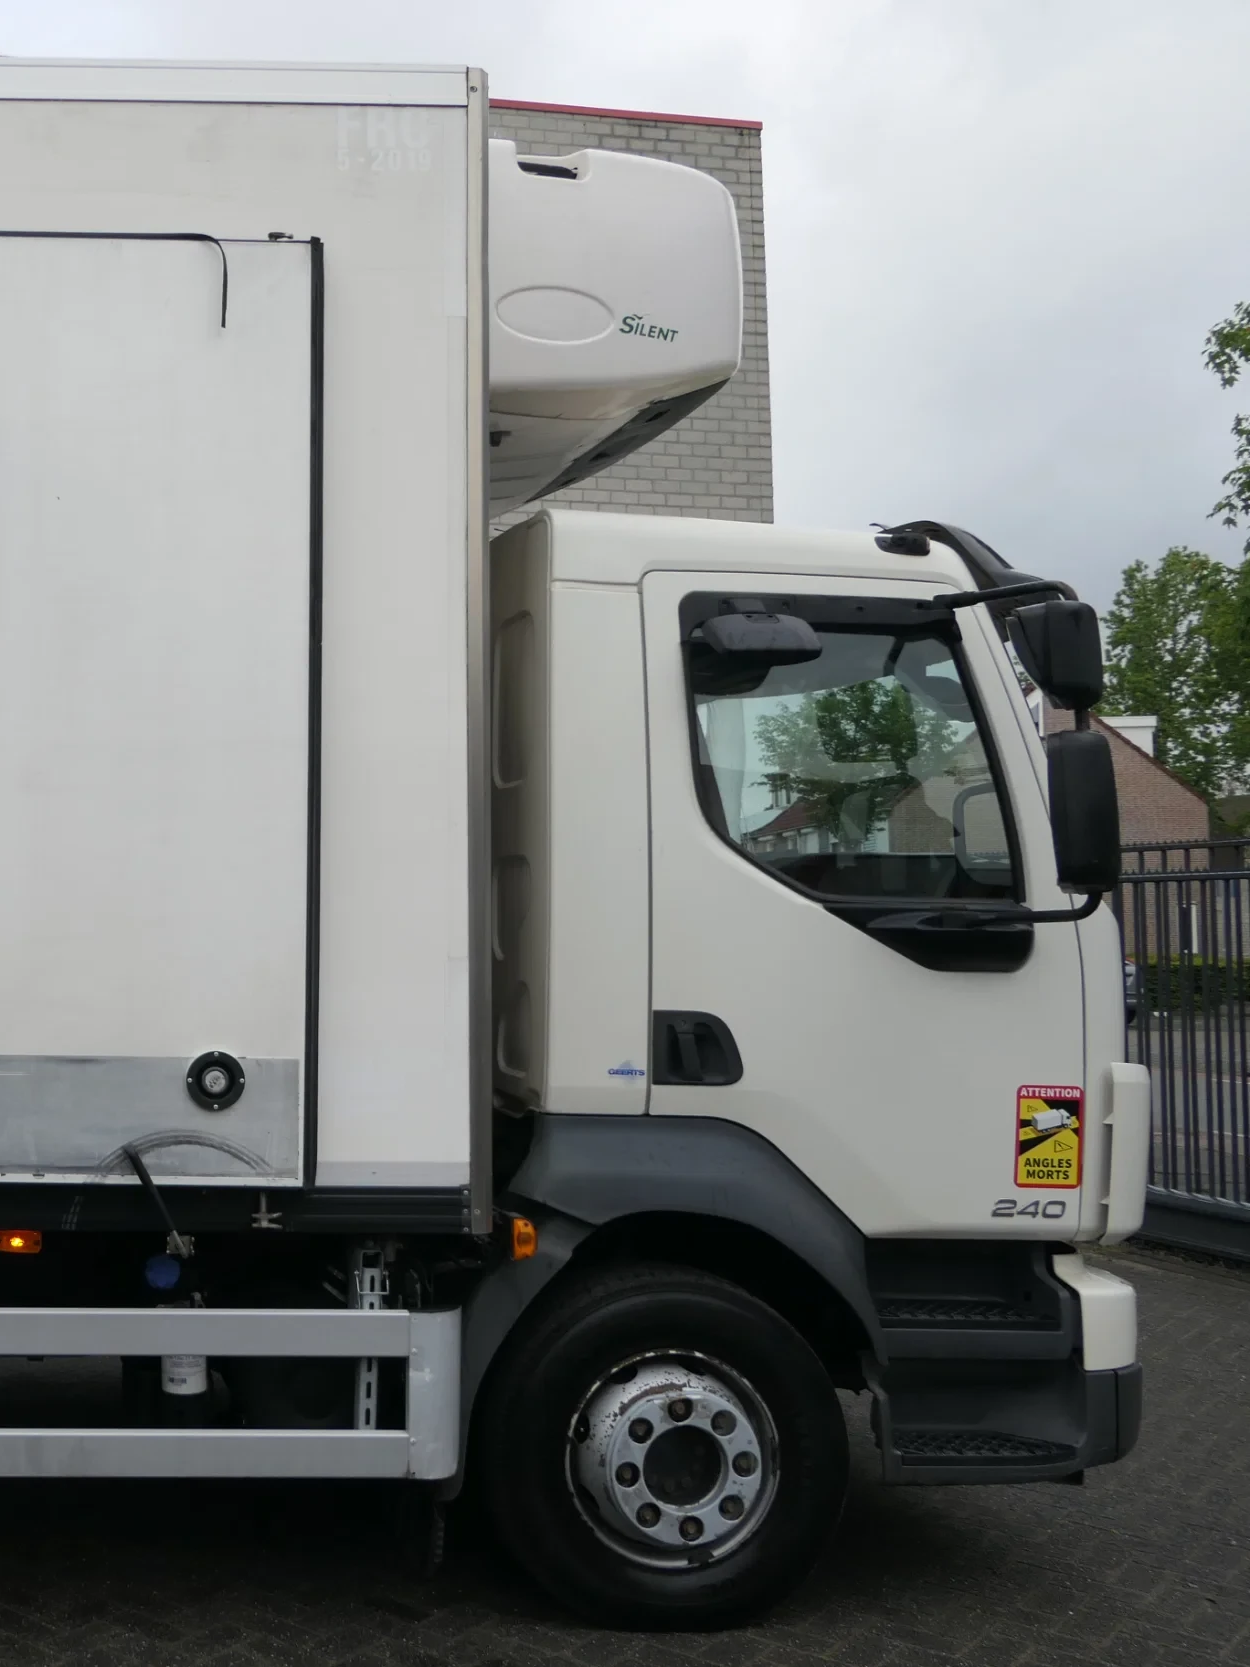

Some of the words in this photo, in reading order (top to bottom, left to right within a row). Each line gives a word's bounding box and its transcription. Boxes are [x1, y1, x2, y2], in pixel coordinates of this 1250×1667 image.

[608, 1068, 646, 1076] GEERTS
[1020, 1087, 1080, 1098] ATTENTION
[1024, 1158, 1072, 1169] ANGLES
[1026, 1169, 1070, 1180] MORTS
[991, 1198, 1066, 1219] 240
